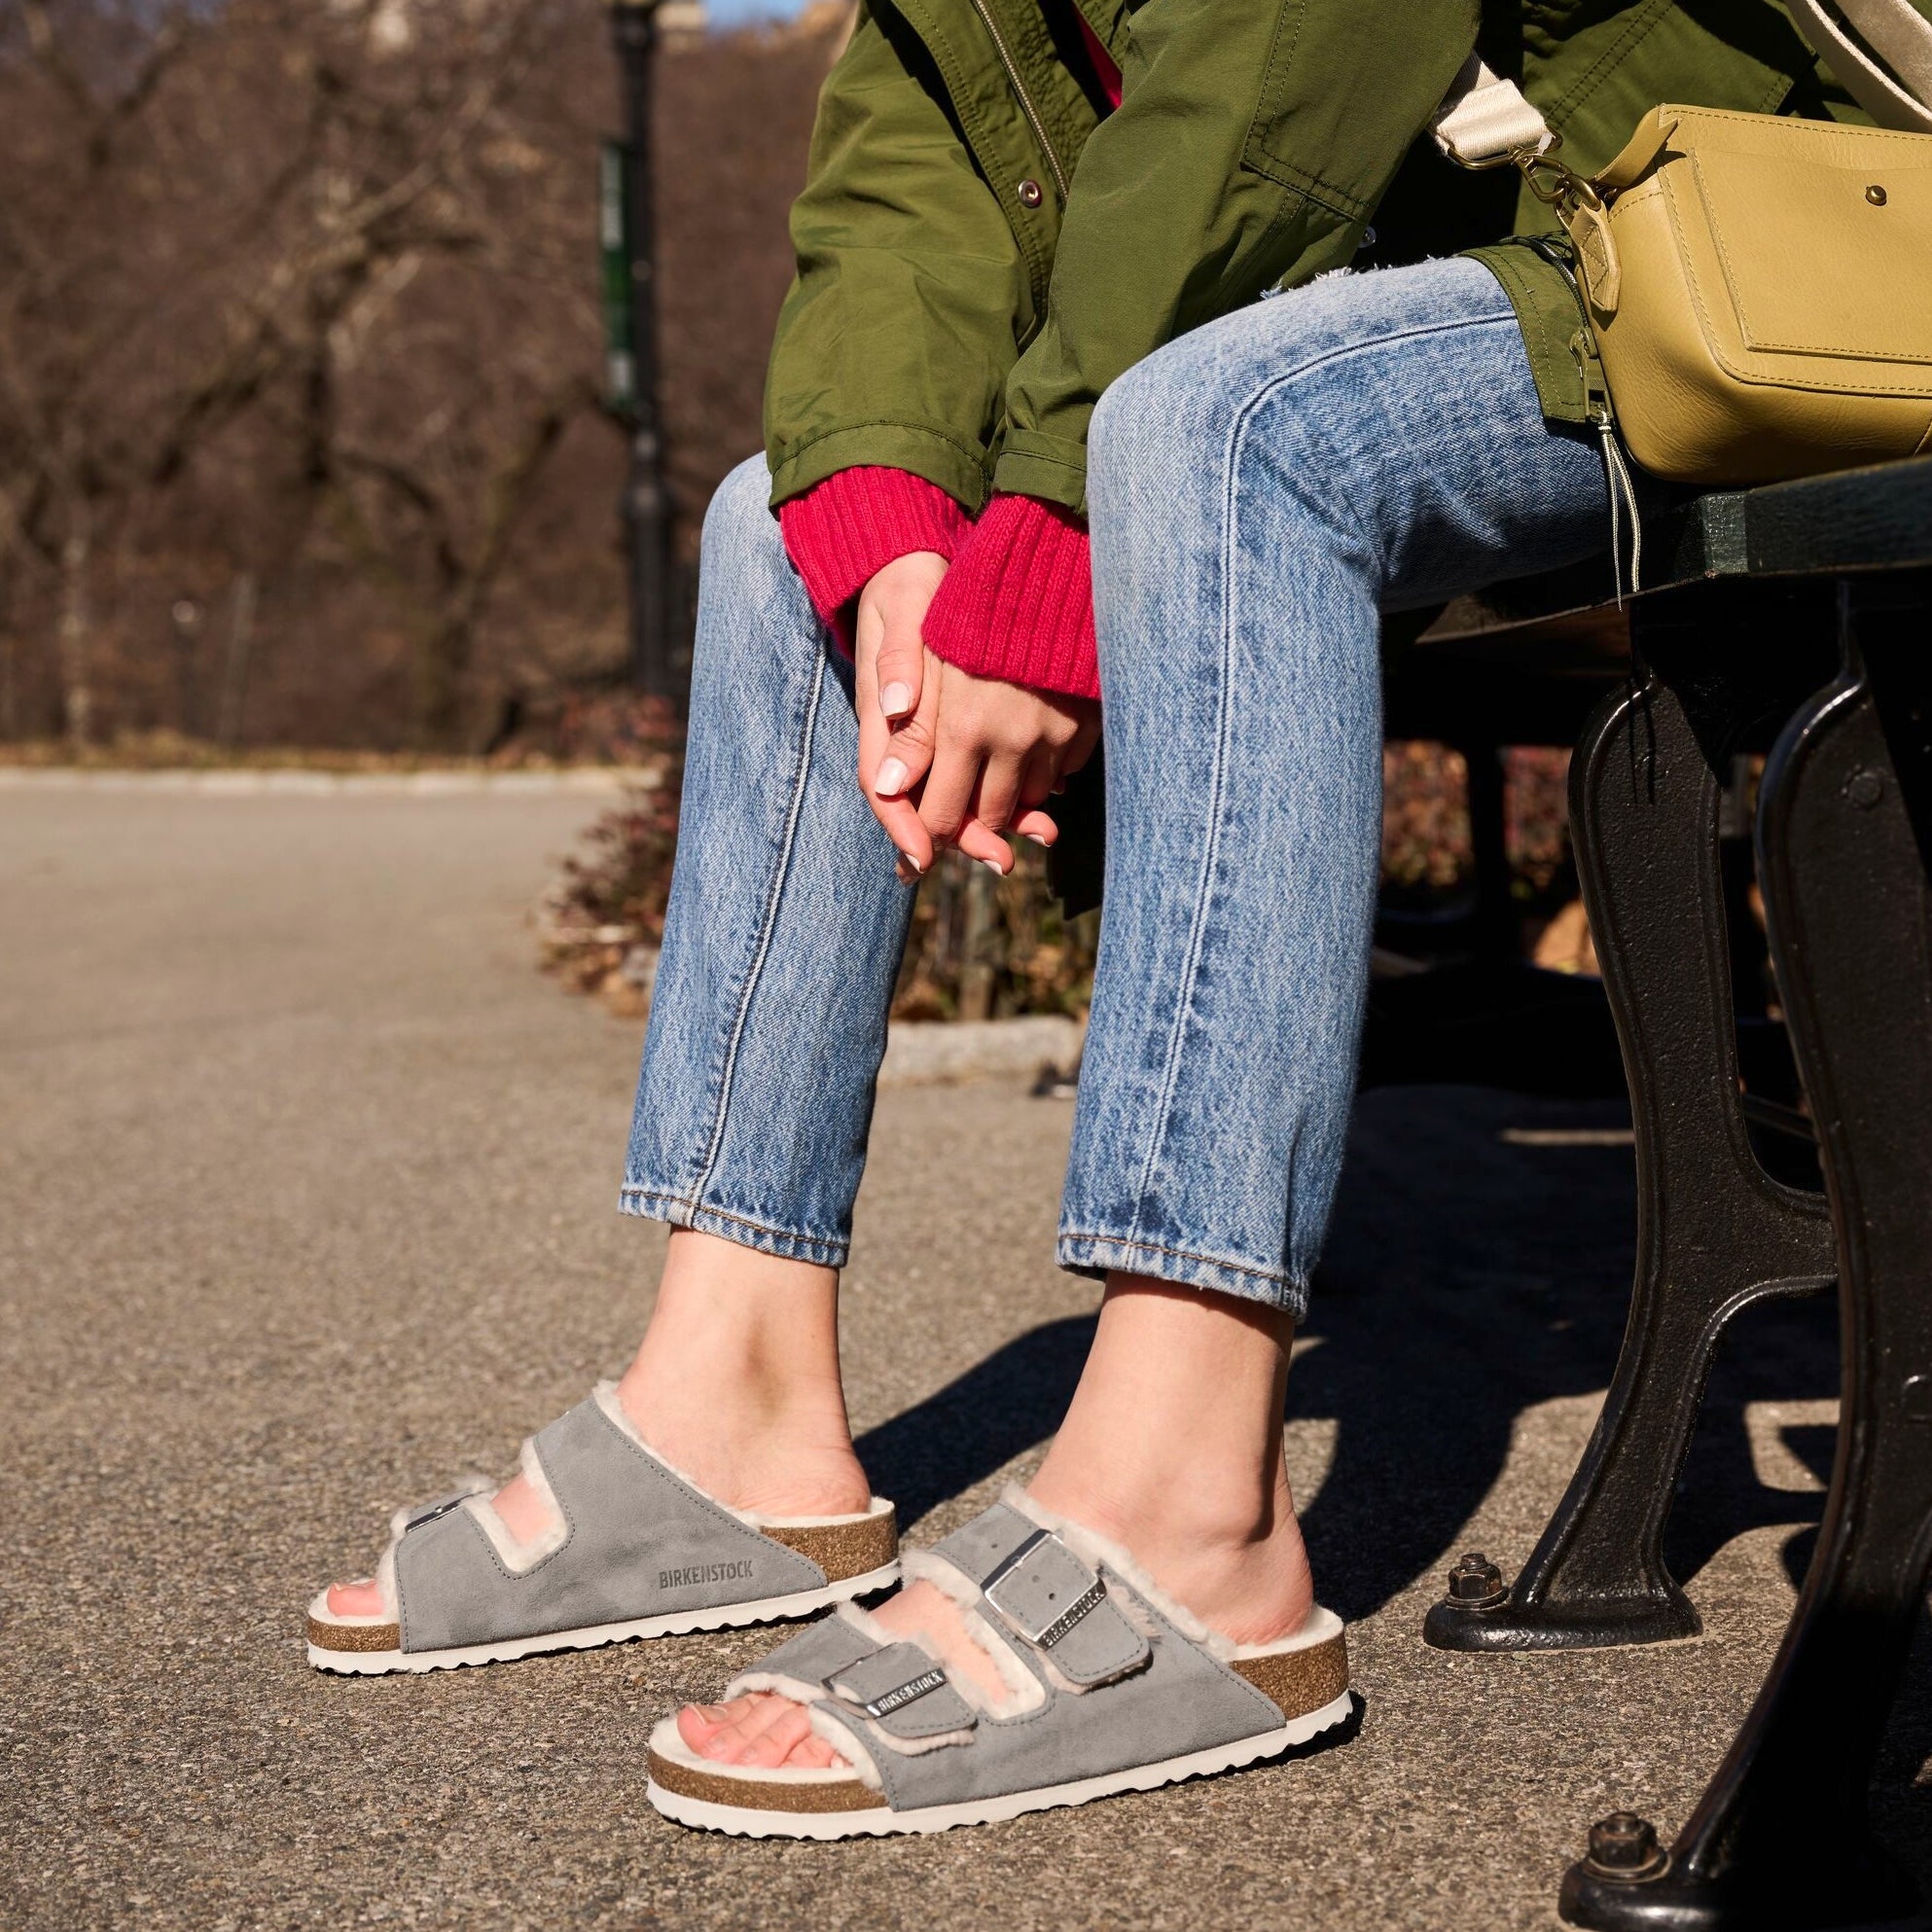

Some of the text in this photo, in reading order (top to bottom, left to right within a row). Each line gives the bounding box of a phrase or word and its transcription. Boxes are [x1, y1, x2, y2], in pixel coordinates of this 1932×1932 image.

[659, 1559, 753, 1590] BIRKENSTOCK
[1042, 1584, 1106, 1646] BIRKENSTOCK
[877, 1670, 943, 1711] BIRKENSTOCK
